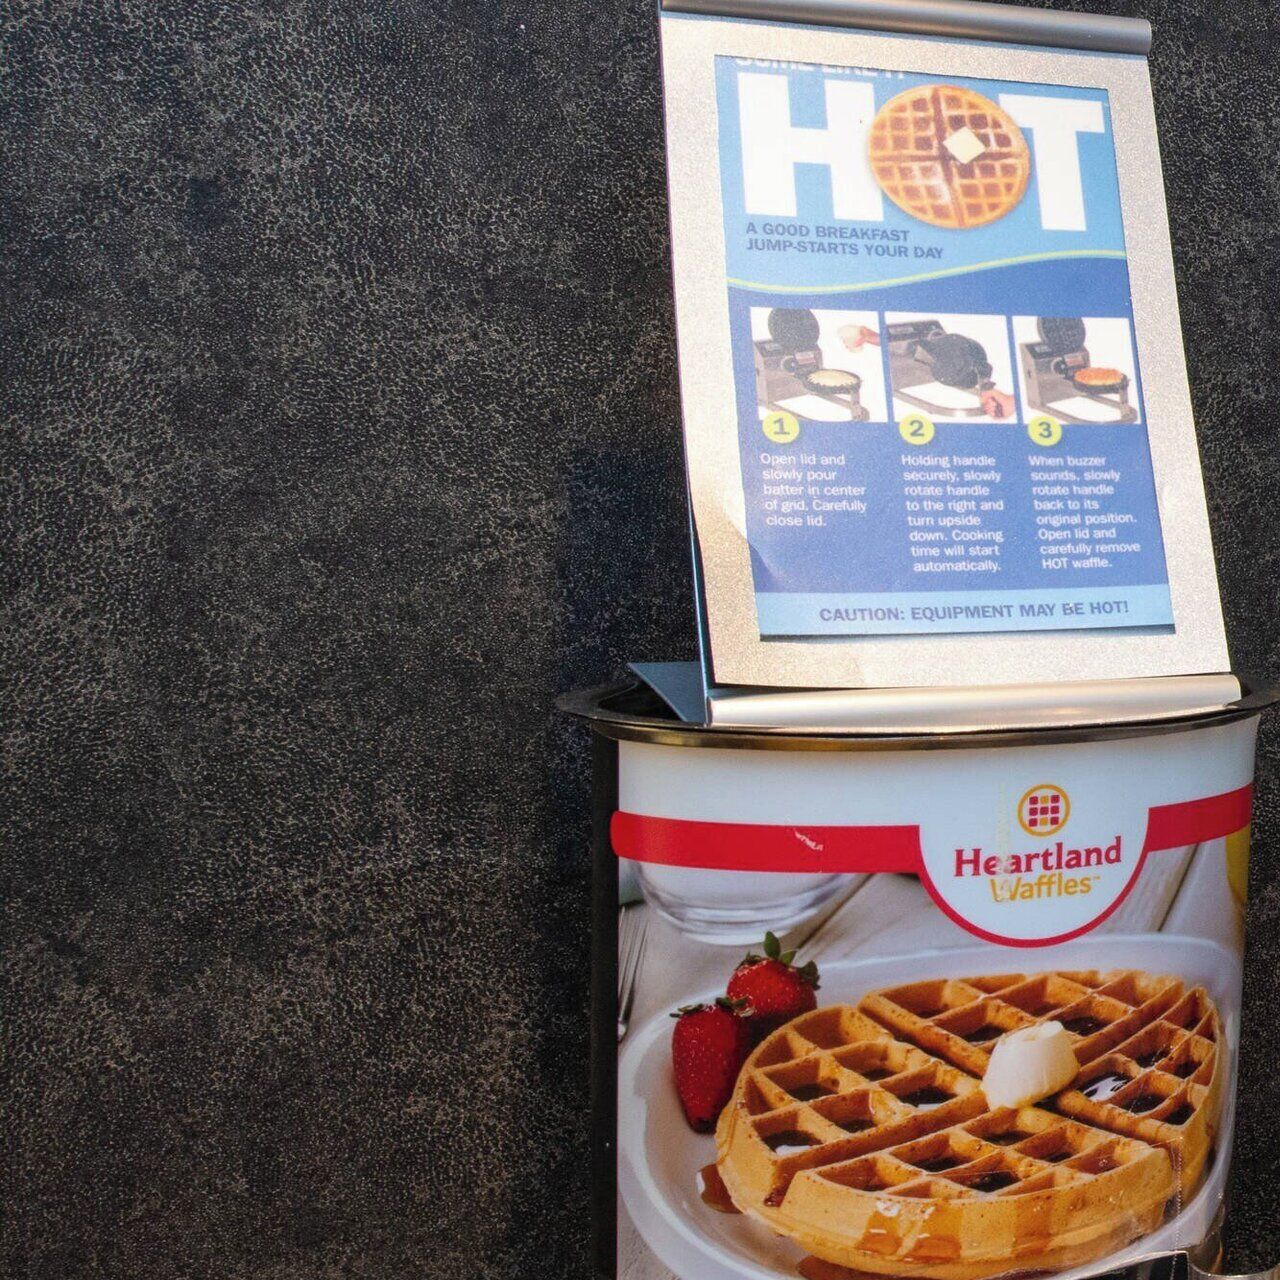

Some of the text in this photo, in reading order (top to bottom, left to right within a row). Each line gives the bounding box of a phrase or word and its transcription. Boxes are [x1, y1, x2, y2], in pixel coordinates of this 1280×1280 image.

[746, 222, 909, 242] A GOOD BREAKFAST
[747, 239, 943, 259] JUMP-STARTS YOUR DAY
[773, 417, 790, 435] 1
[909, 419, 925, 437] 2
[1038, 421, 1052, 438] 3
[760, 453, 845, 466] Open lid and
[901, 455, 996, 468] Holding handle
[1028, 456, 1106, 466] When buzzer
[762, 469, 837, 482] slowly pour
[903, 471, 1001, 483] securely, slowly
[1031, 470, 1120, 482] sounds, slowly
[763, 484, 866, 495] batter in center
[904, 485, 990, 495] rotate handle
[1032, 485, 1114, 495] rotate handle
[765, 499, 867, 513] of grid. Carefully
[906, 500, 1004, 513] to the right and
[1034, 500, 1099, 510] back to its
[766, 516, 827, 526] close lid.
[908, 516, 981, 527] turn upside
[1036, 513, 1137, 527] original position.
[909, 530, 1004, 542] down. Cooking
[1038, 528, 1116, 541] Open lid and
[911, 545, 1000, 556] time will start
[1040, 543, 1141, 555] carefully remove
[913, 560, 1001, 573] automatically.
[1042, 557, 1112, 569] HOT waffle.
[820, 600, 1130, 622] CAUTION: EQUIPMENT MAY BE HOT!
[954, 835, 1122, 877] Heartland
